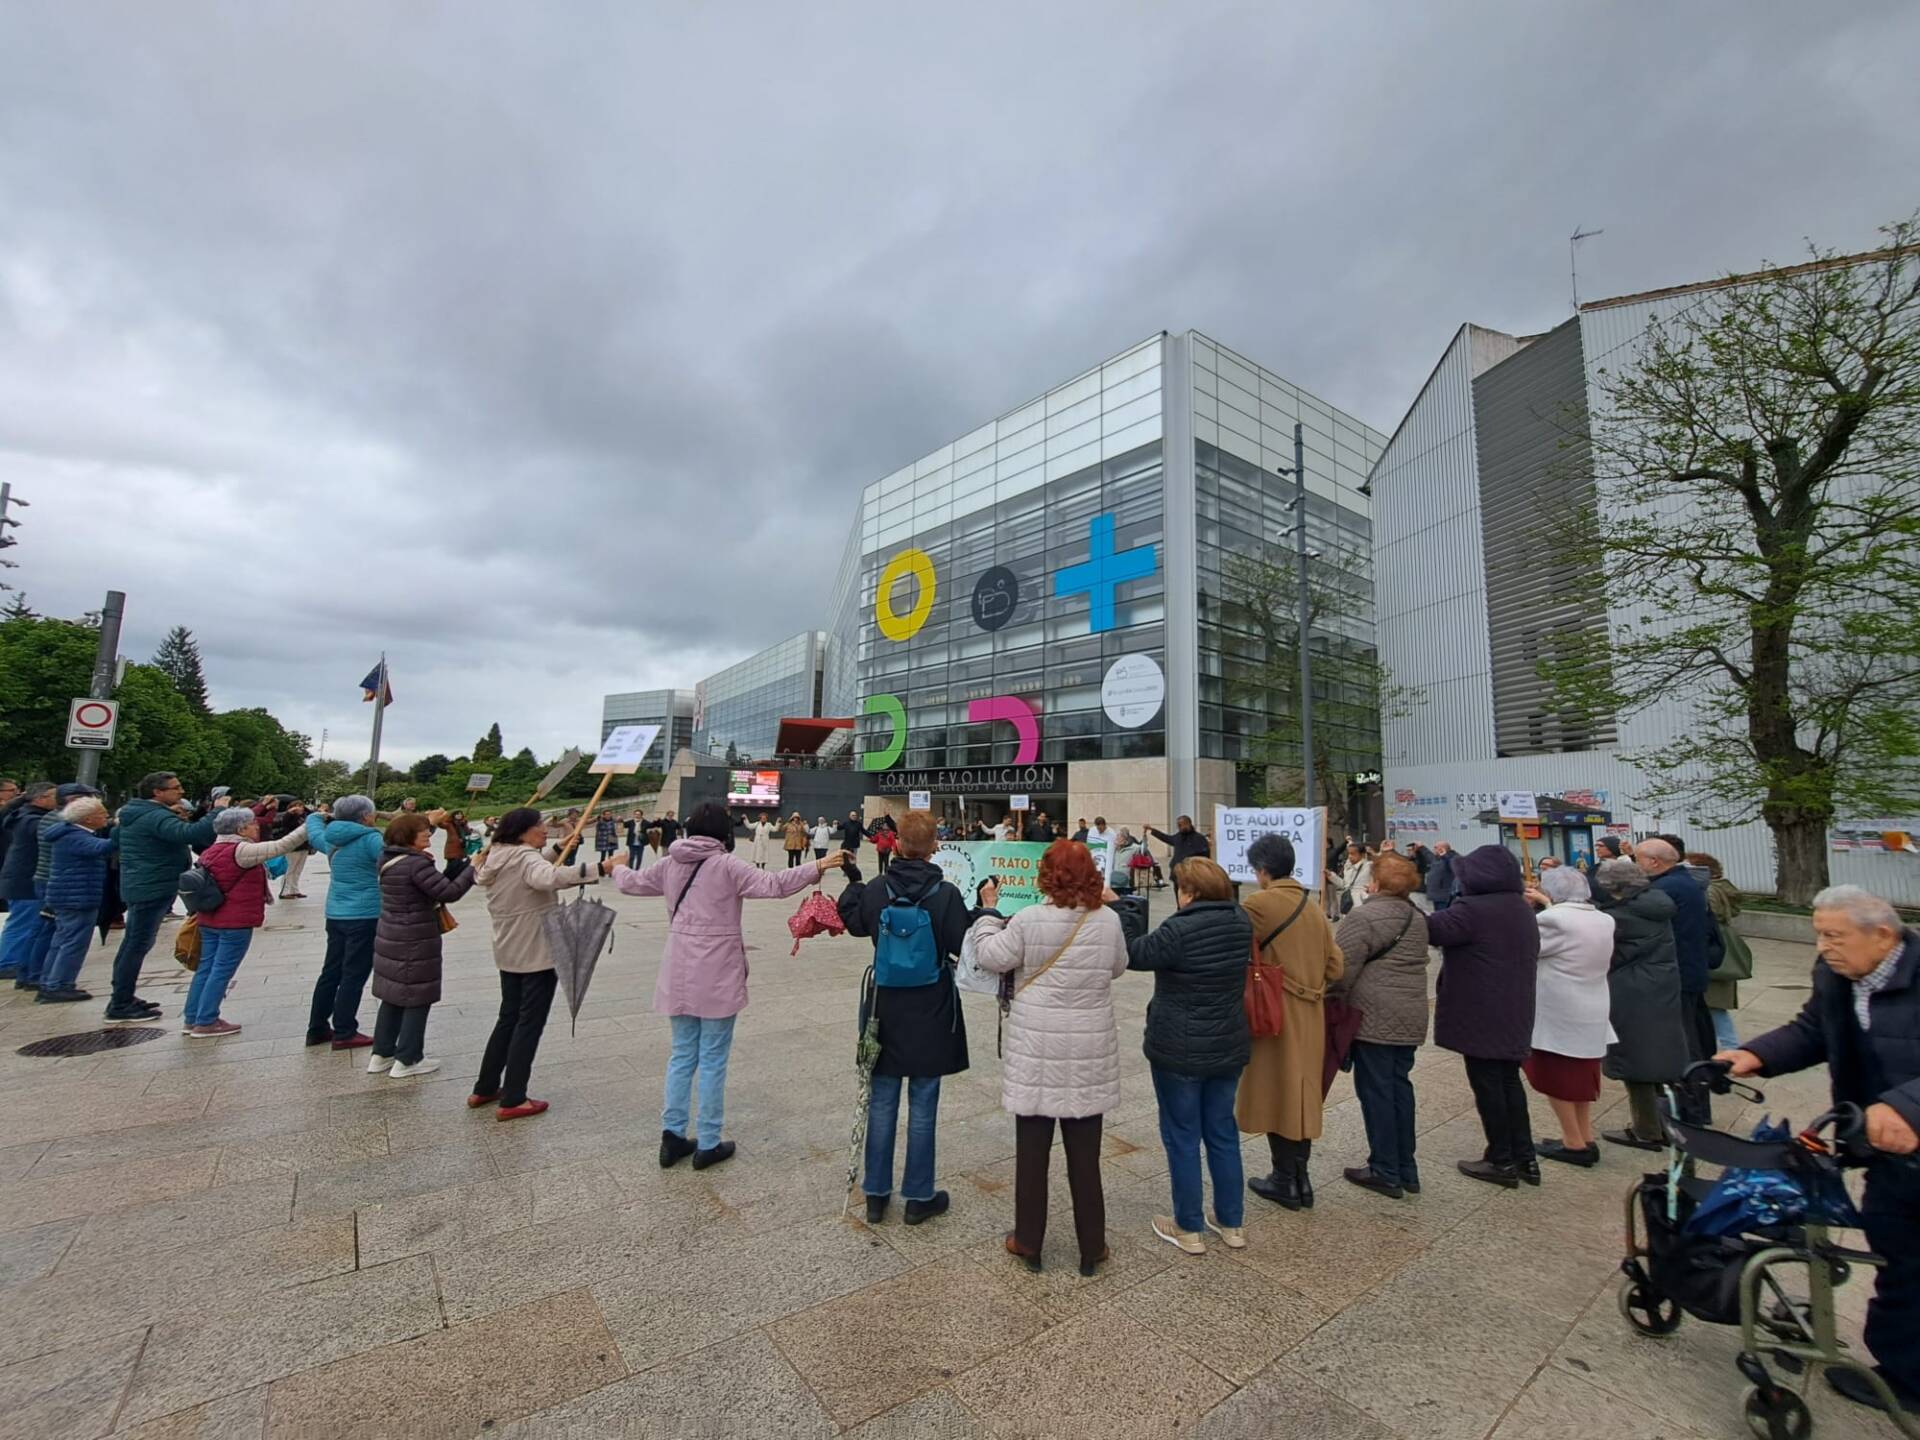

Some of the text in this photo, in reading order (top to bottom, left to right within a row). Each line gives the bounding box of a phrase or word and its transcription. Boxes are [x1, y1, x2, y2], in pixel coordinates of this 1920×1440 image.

[878, 766, 1055, 786] FÓRUM EVOLUCIÓN
[1223, 813, 1243, 825] DE
[1293, 814, 1305, 826] O
[1226, 829, 1246, 841] DE
[991, 857, 1031, 870] TRATO
